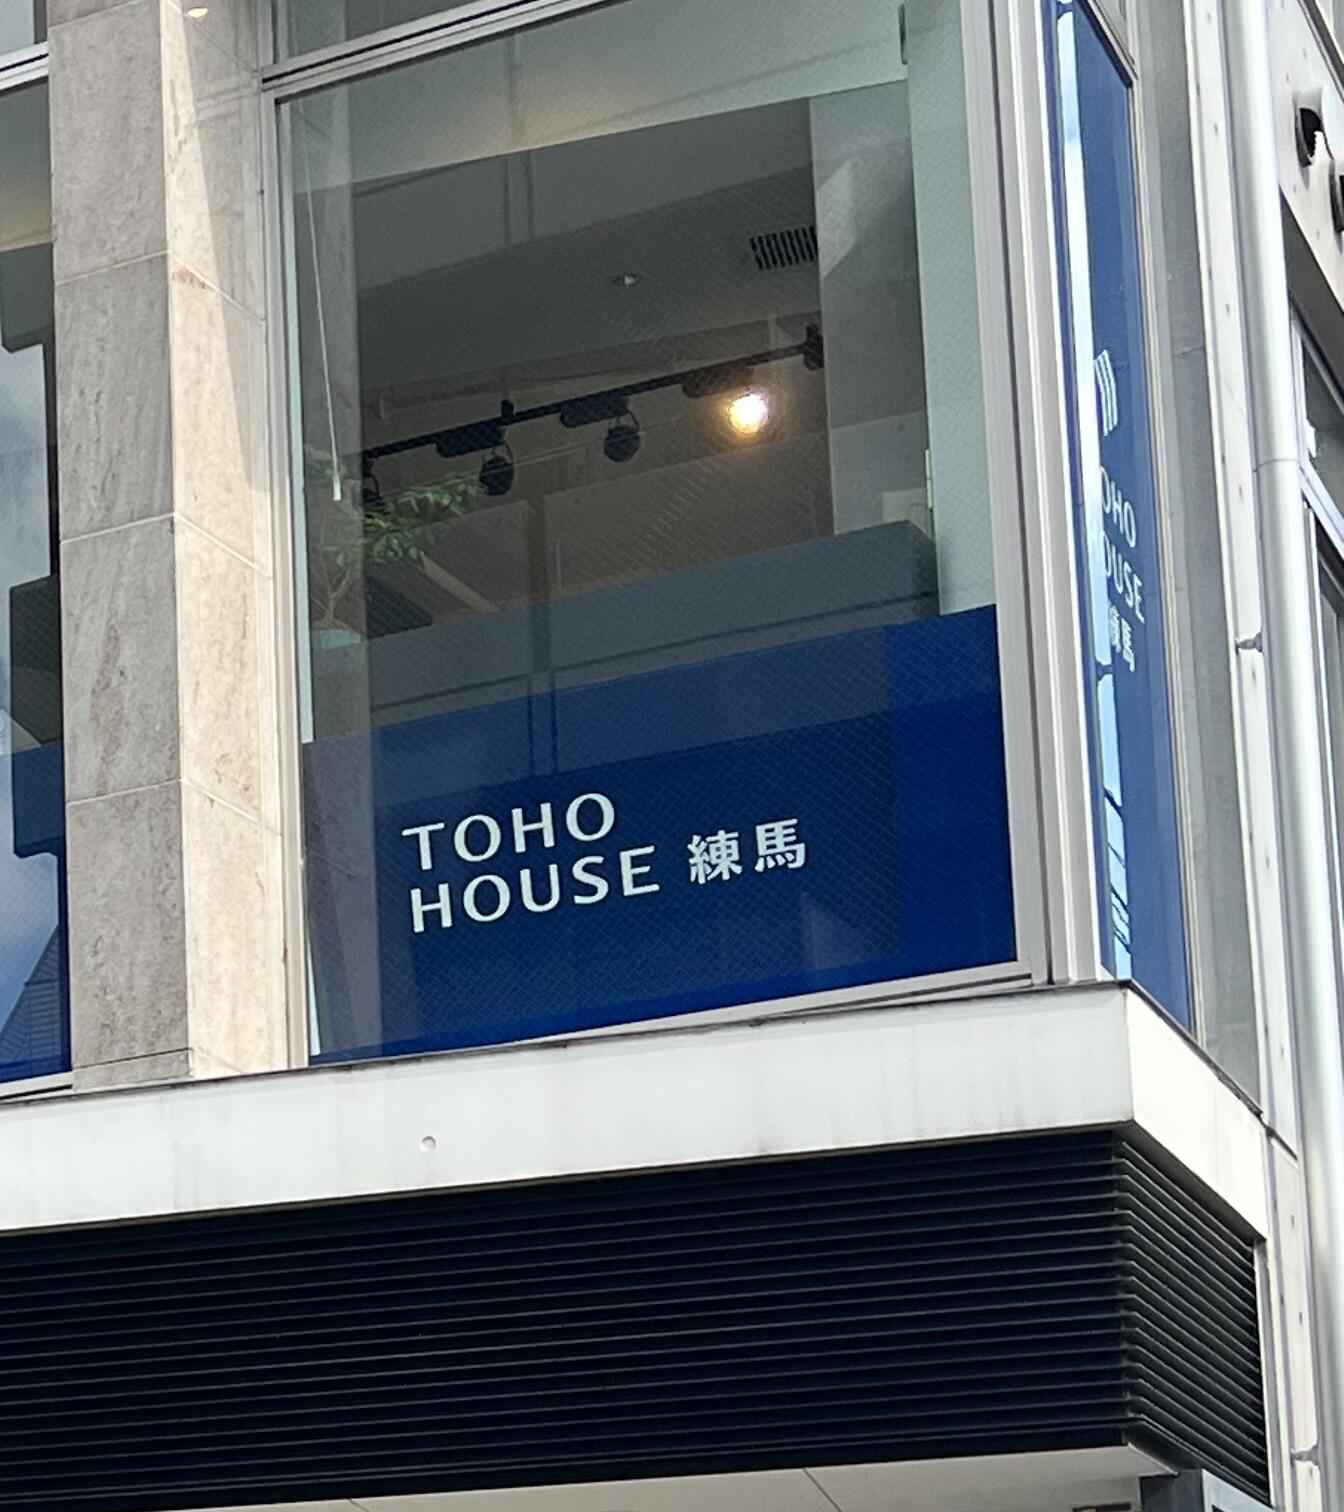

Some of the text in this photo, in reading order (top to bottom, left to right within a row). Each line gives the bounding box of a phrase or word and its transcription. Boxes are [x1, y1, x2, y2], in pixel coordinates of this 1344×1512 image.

[1099, 464, 1136, 548] OHO
[1102, 530, 1145, 625] OUSE
[402, 792, 615, 871] TOHO
[410, 818, 807, 933] HOUSE 練馬
